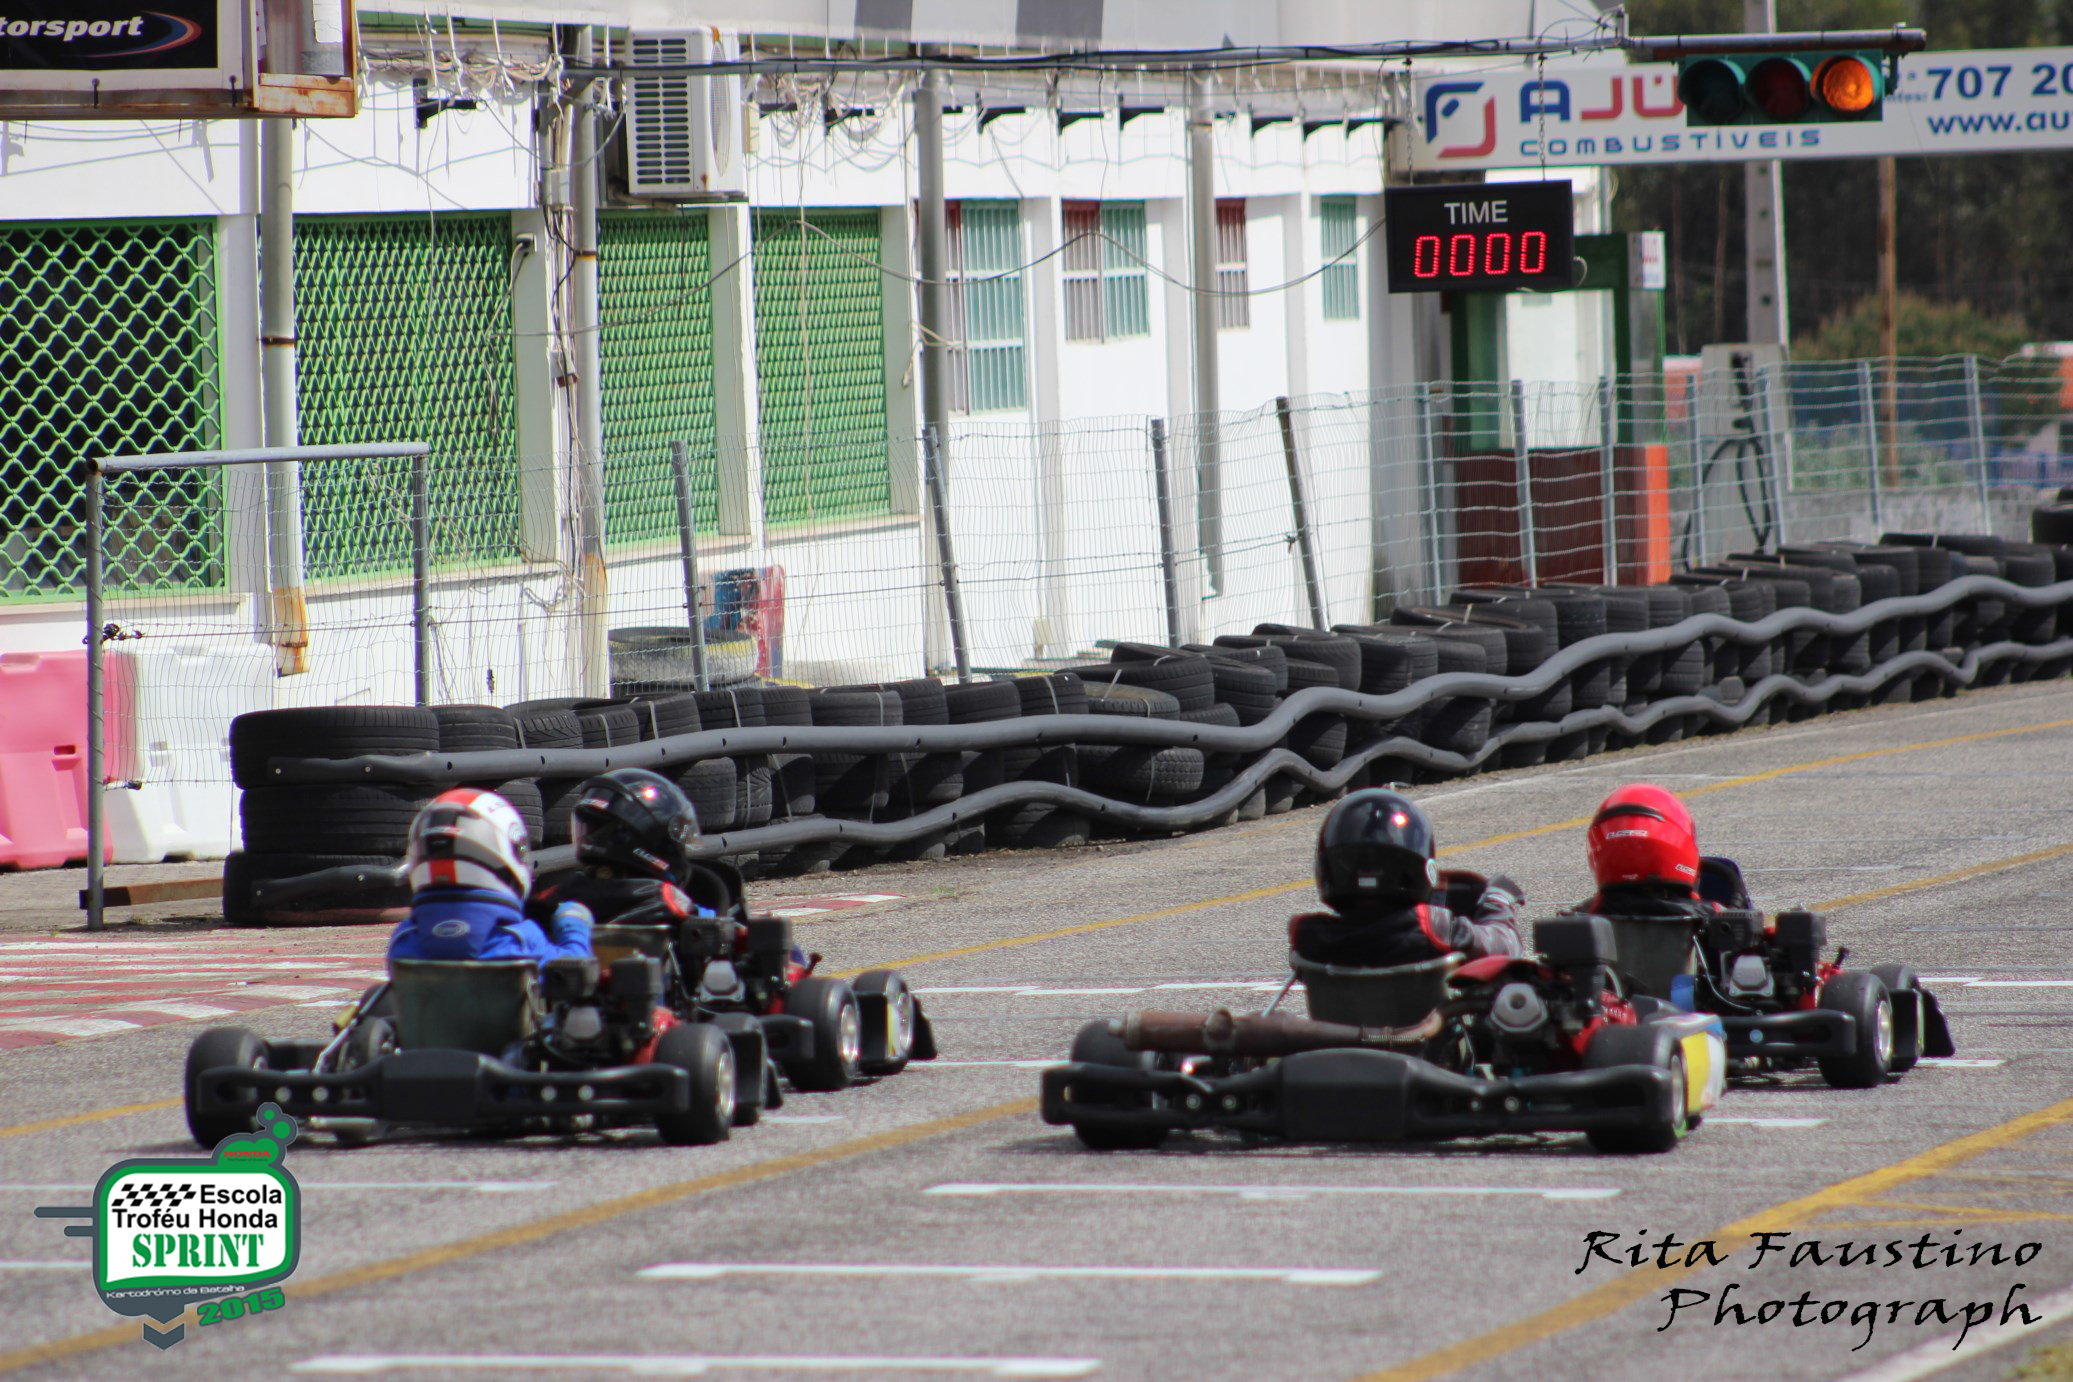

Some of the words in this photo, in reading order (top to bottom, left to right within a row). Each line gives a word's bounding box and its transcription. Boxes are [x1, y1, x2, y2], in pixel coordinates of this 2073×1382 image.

[1927, 65, 2013, 99] 707
[1520, 129, 1820, 157] COMBUSTÍVEIS
[1444, 200, 1508, 225] TIME
